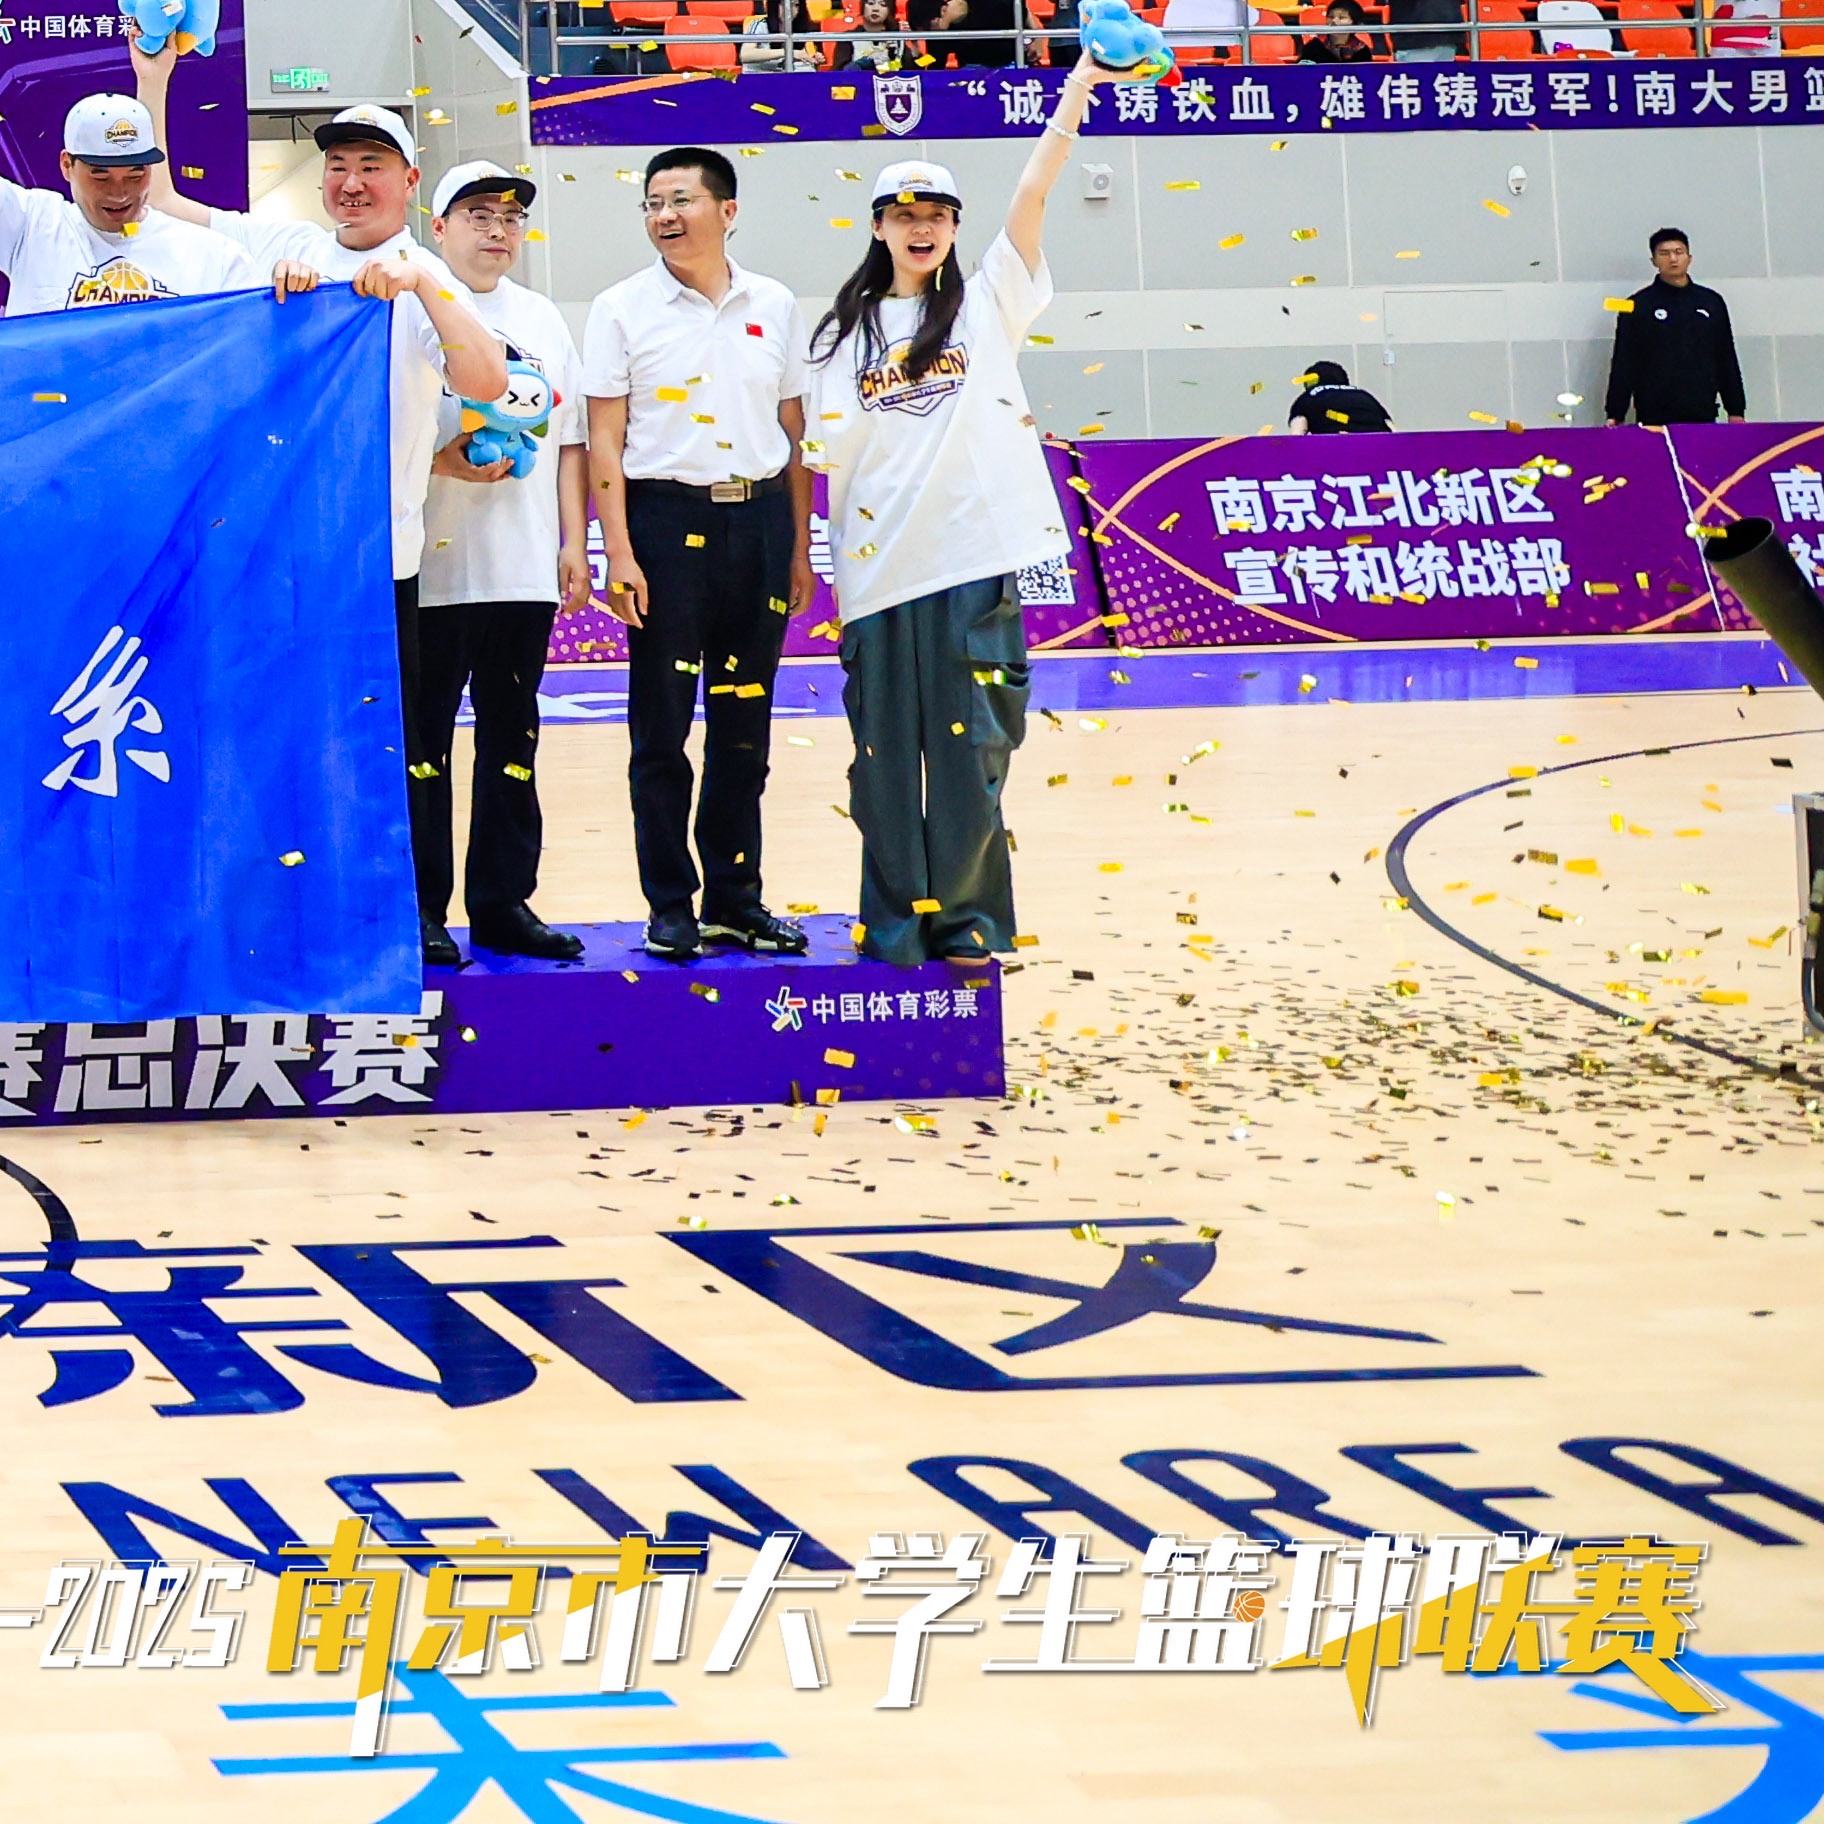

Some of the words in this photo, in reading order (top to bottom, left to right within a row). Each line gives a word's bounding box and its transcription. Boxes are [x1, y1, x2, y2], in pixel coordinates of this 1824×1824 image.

[1205, 466, 1556, 535] 南京江北新区
[1224, 537, 1572, 606] 宣传和统战部
[812, 988, 979, 1024] 中国体育彩票
